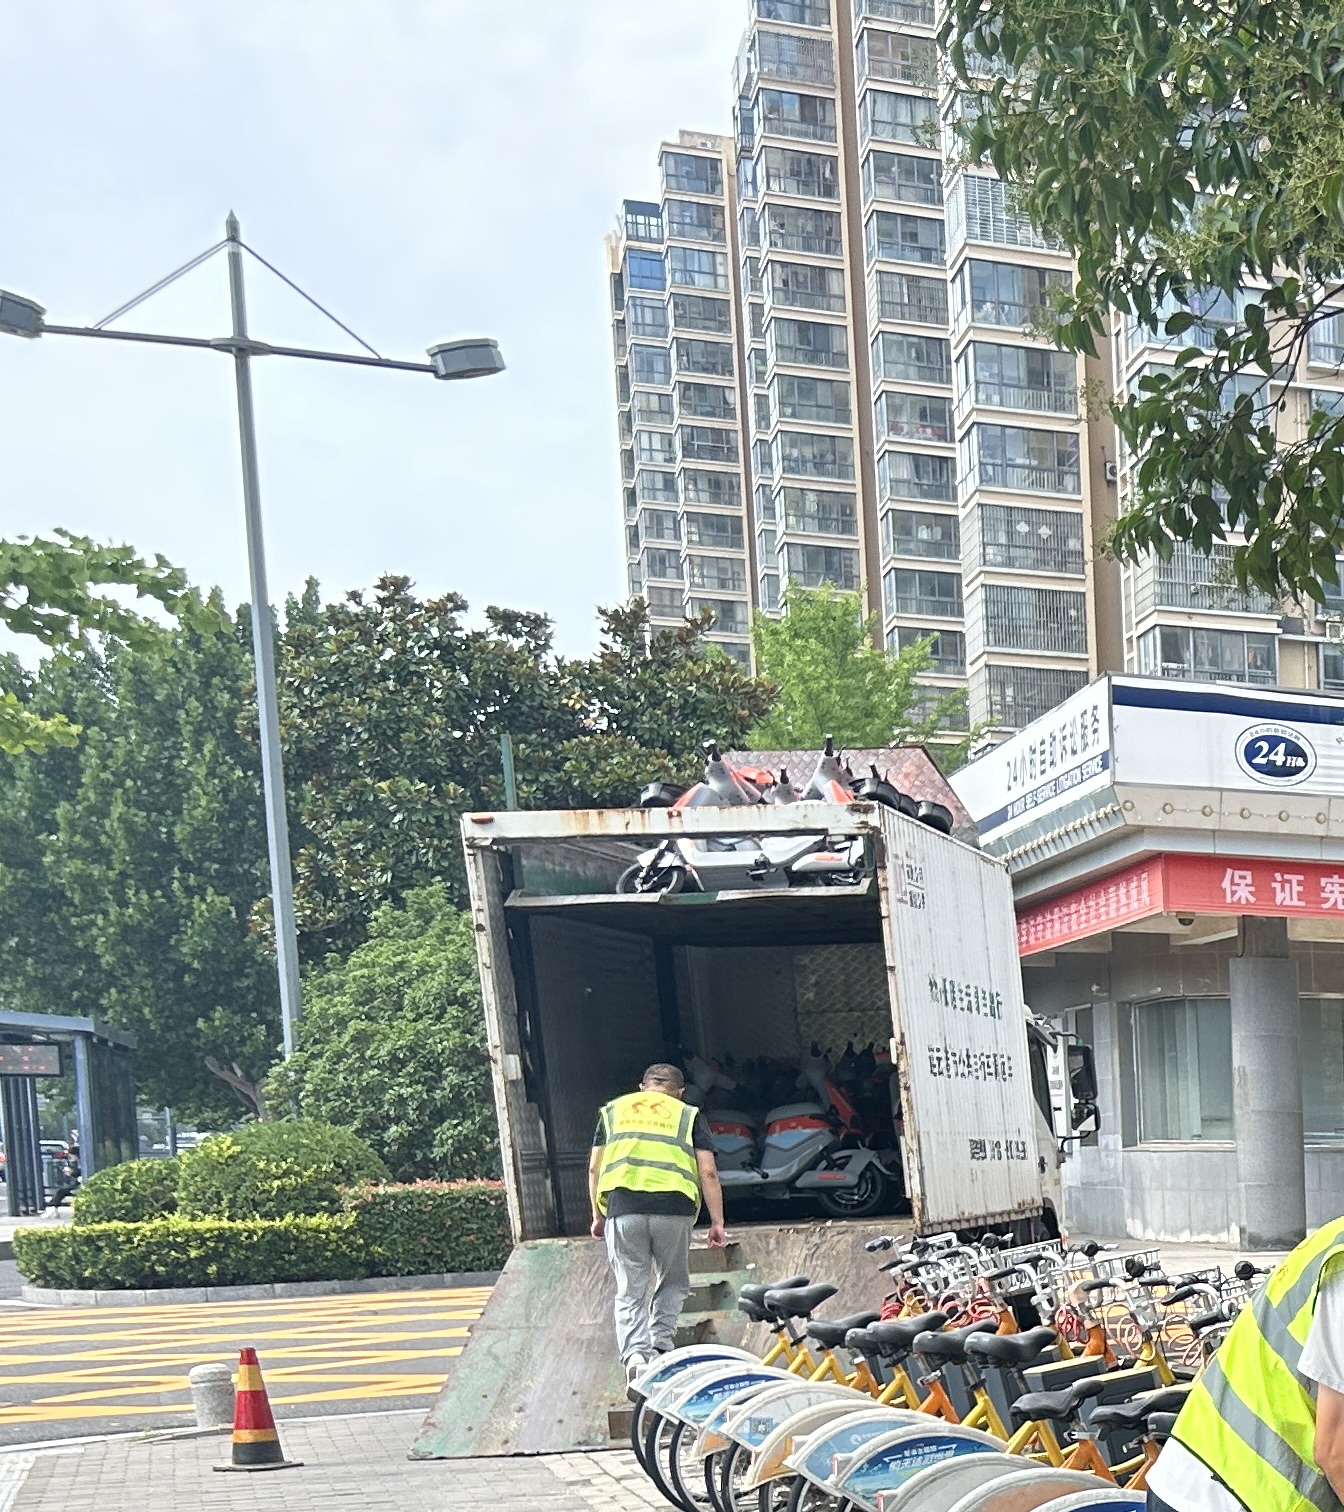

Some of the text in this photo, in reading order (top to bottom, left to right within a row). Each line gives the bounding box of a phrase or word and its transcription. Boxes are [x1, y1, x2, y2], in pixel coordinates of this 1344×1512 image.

[1006, 702, 1101, 792] 24小时自助诉讼服务
